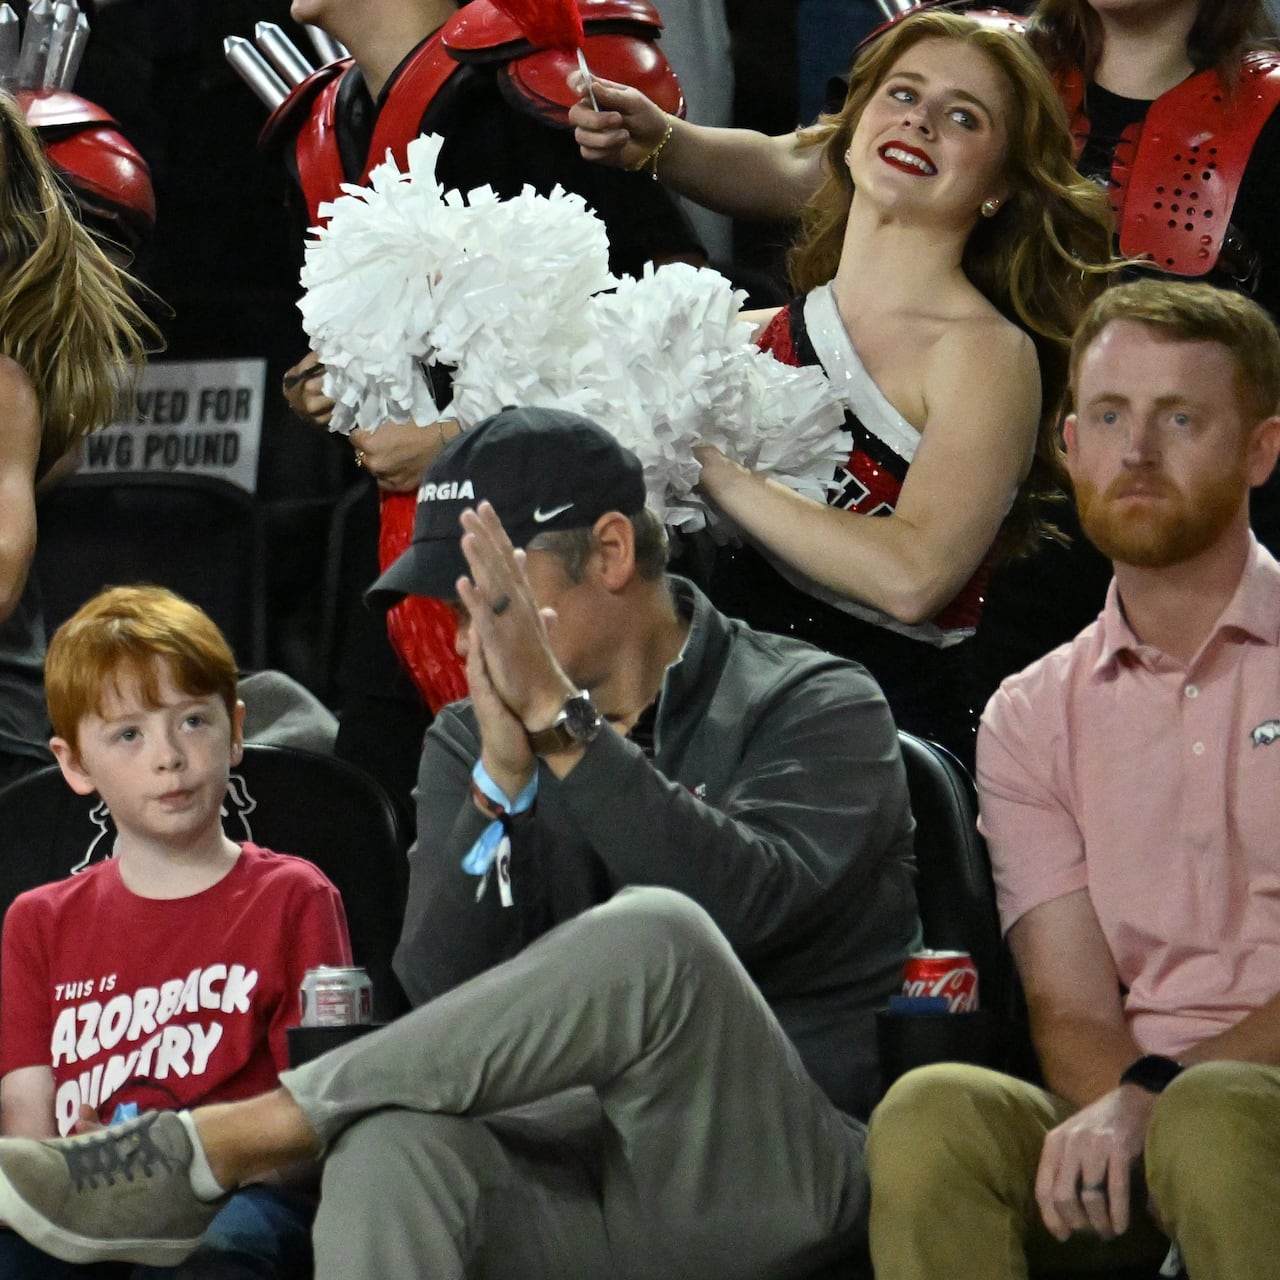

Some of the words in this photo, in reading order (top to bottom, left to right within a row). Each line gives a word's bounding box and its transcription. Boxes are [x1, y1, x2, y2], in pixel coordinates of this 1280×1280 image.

[199, 388, 253, 423] FOR
[143, 431, 239, 468] POUND
[417, 479, 475, 504] RGIA
[55, 978, 94, 1001] THIS
[99, 973, 117, 993] IS
